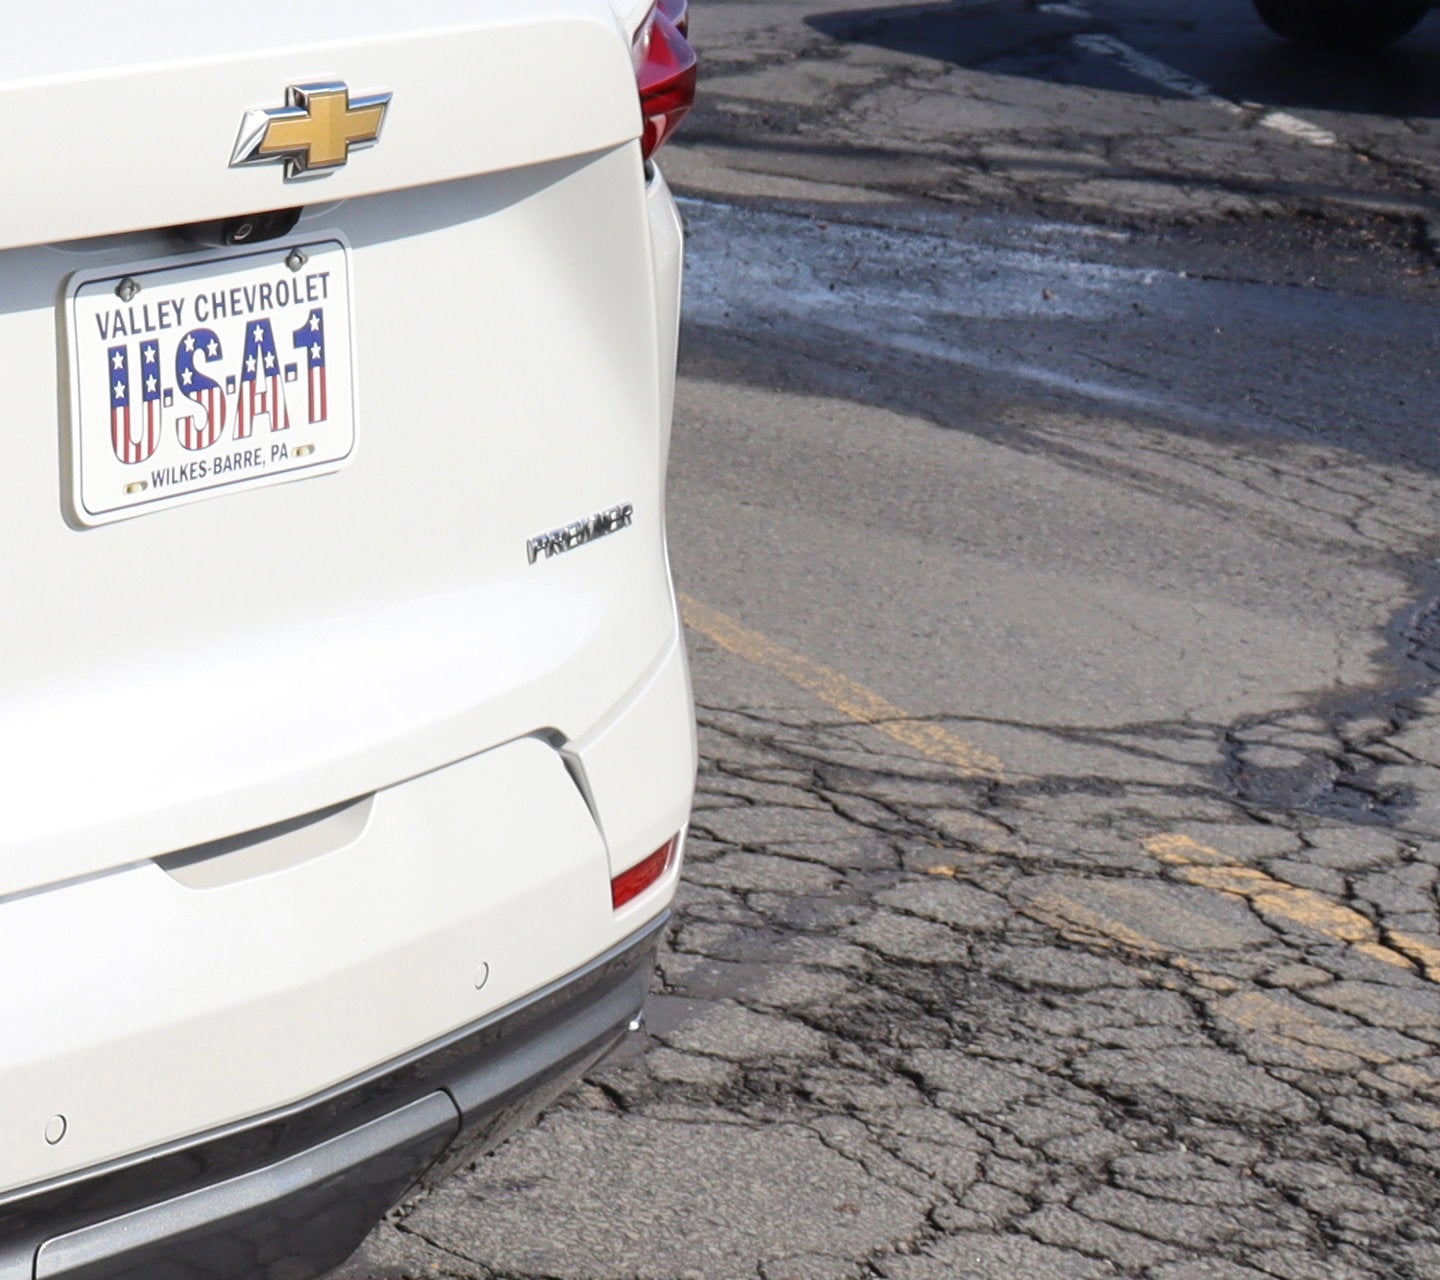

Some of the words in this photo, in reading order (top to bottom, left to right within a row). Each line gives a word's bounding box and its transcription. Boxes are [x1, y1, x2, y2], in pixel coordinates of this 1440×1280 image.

[95, 297, 185, 341] VALLEY
[194, 272, 330, 322] CHEVROLET
[151, 446, 266, 489] WILKES-BARRE,
[270, 442, 289, 462] PA
[526, 500, 634, 566] PREMIER
